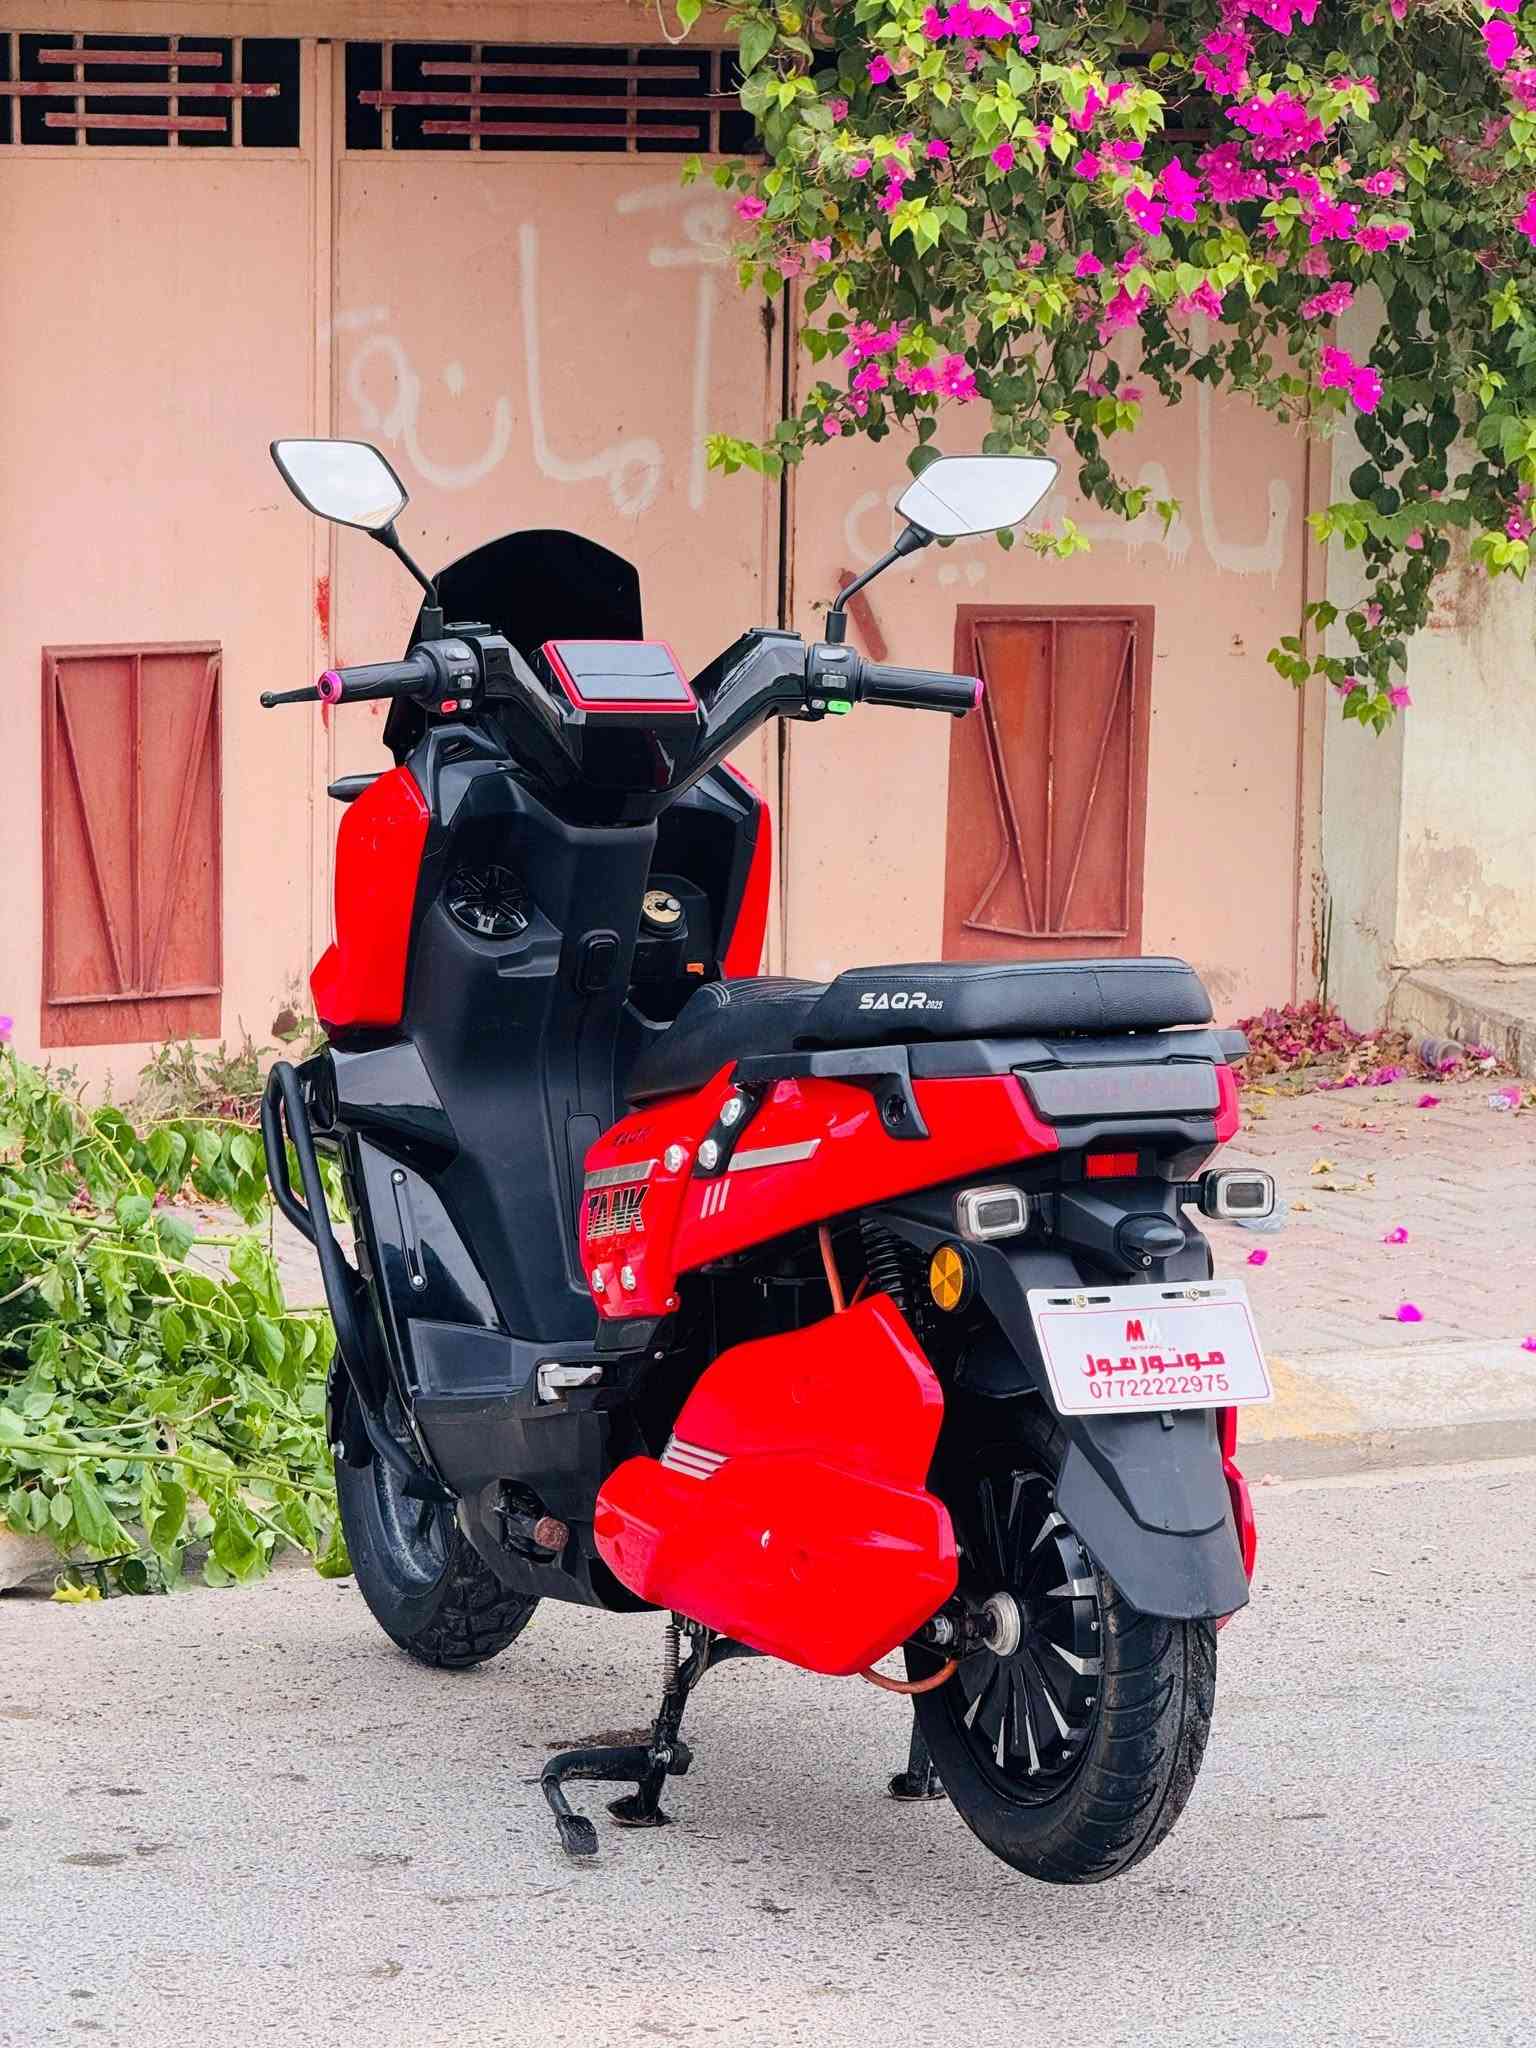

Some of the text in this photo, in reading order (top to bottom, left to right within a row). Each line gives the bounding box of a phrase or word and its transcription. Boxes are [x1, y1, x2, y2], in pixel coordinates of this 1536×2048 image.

[858, 991, 927, 1009] SAQR
[586, 1183, 650, 1240] TANK
[1089, 1374, 1230, 1399] 07722222975
